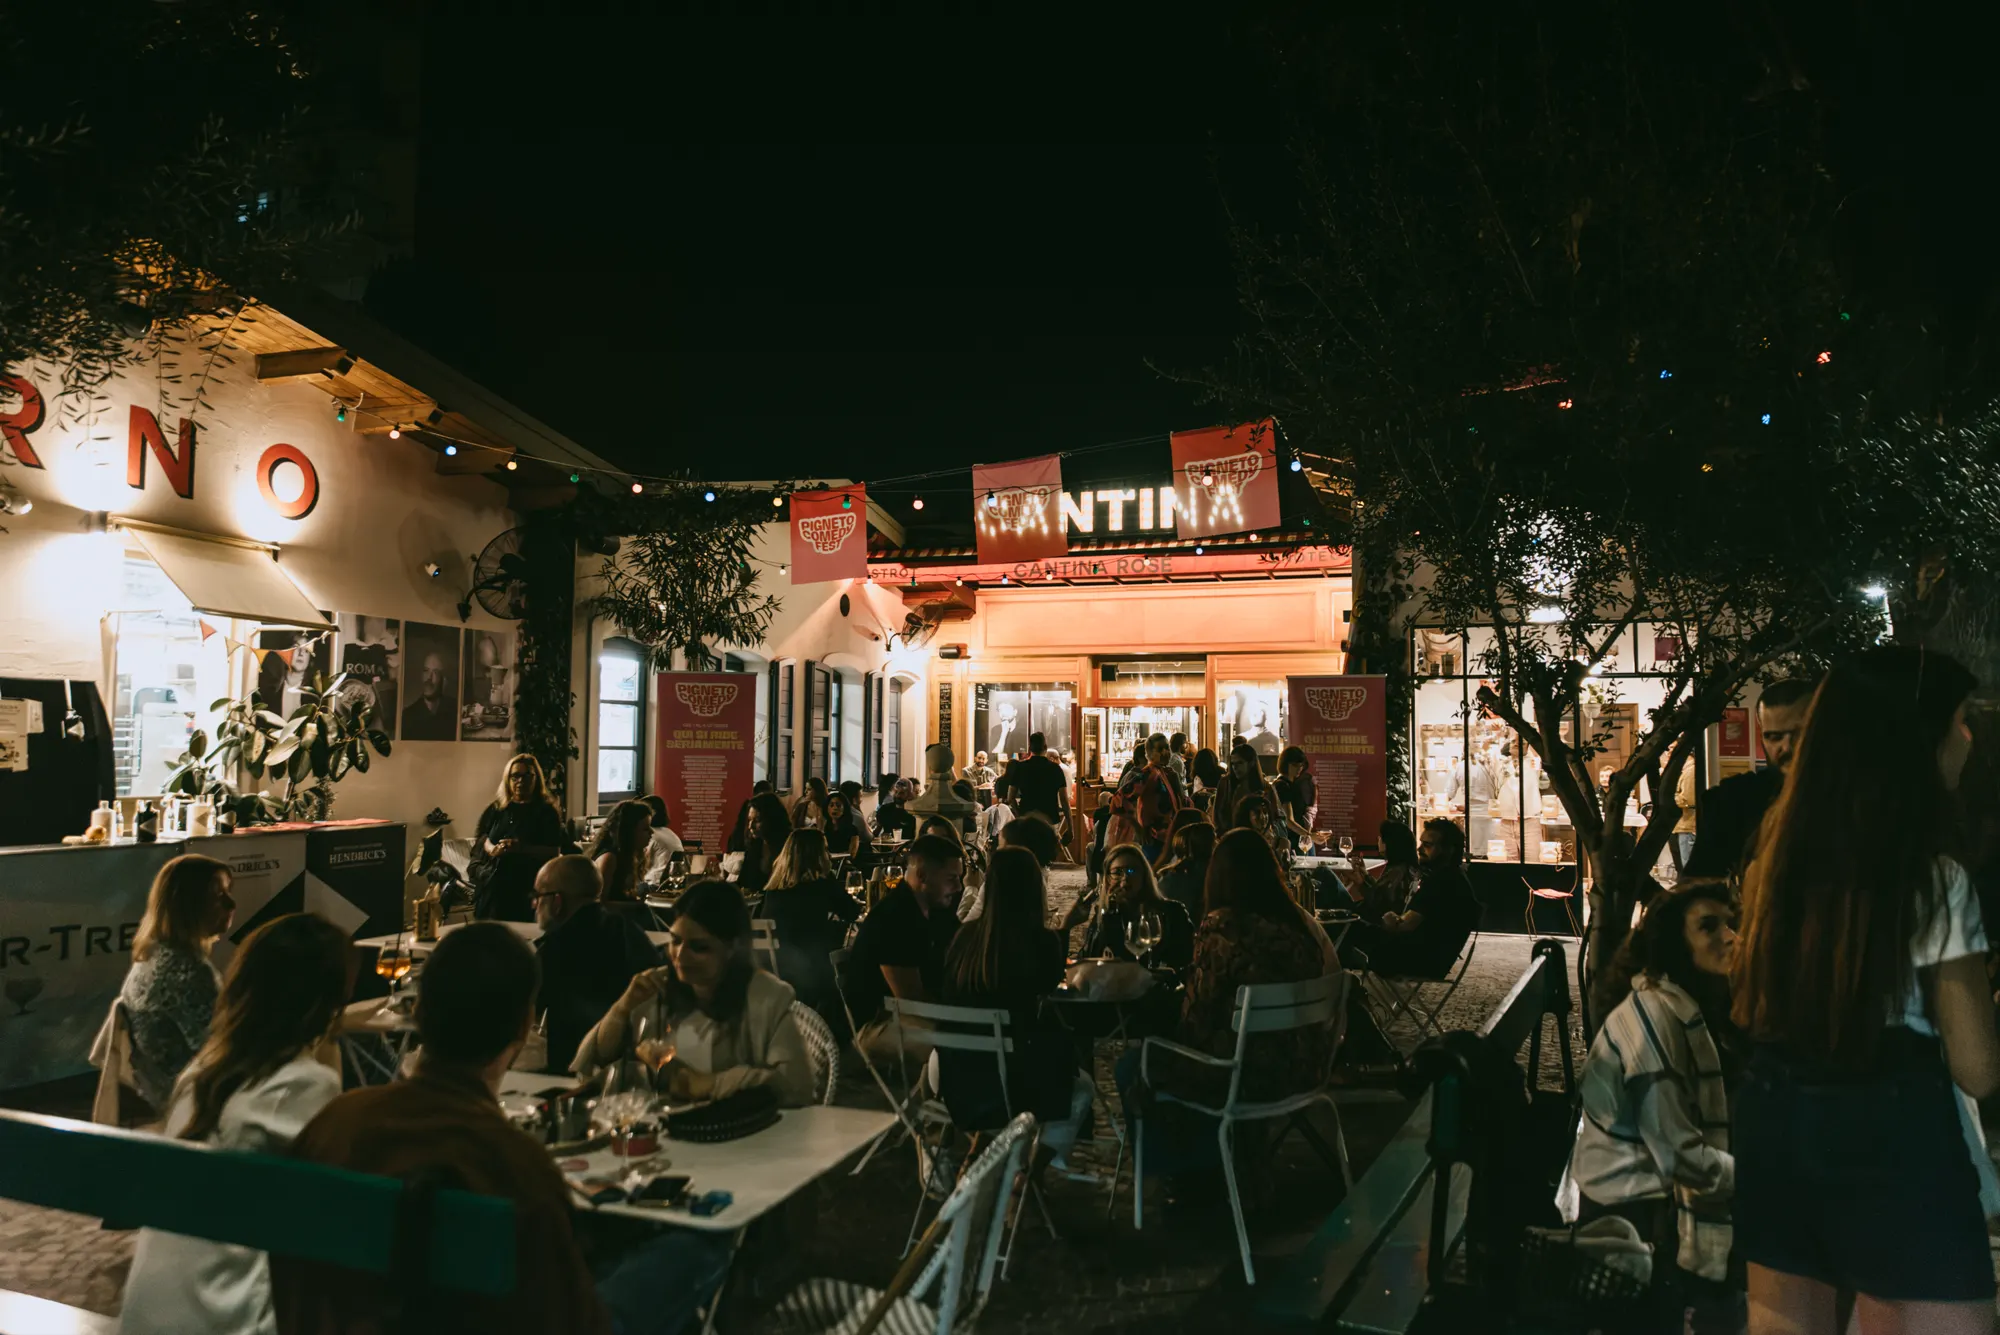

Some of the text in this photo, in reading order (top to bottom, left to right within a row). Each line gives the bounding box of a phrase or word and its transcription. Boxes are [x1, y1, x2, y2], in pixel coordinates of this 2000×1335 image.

[1188, 454, 1259, 475] PIGNETO
[1191, 465, 1258, 487] CMEDY
[801, 515, 854, 530] PIGNETO
[803, 525, 853, 541] COMEDY
[815, 539, 840, 551] FEST
[1014, 560, 1108, 578] CANTINA
[346, 663, 385, 675] ROMA
[678, 685, 735, 695] PIGNETO
[1307, 689, 1364, 699] PIGNETO
[680, 694, 734, 705] COMEDY
[1309, 698, 1363, 710] COMEDY
[692, 704, 720, 714] FEST
[1321, 709, 1349, 718] FEST
[329, 849, 387, 864] HENDRICK'S
